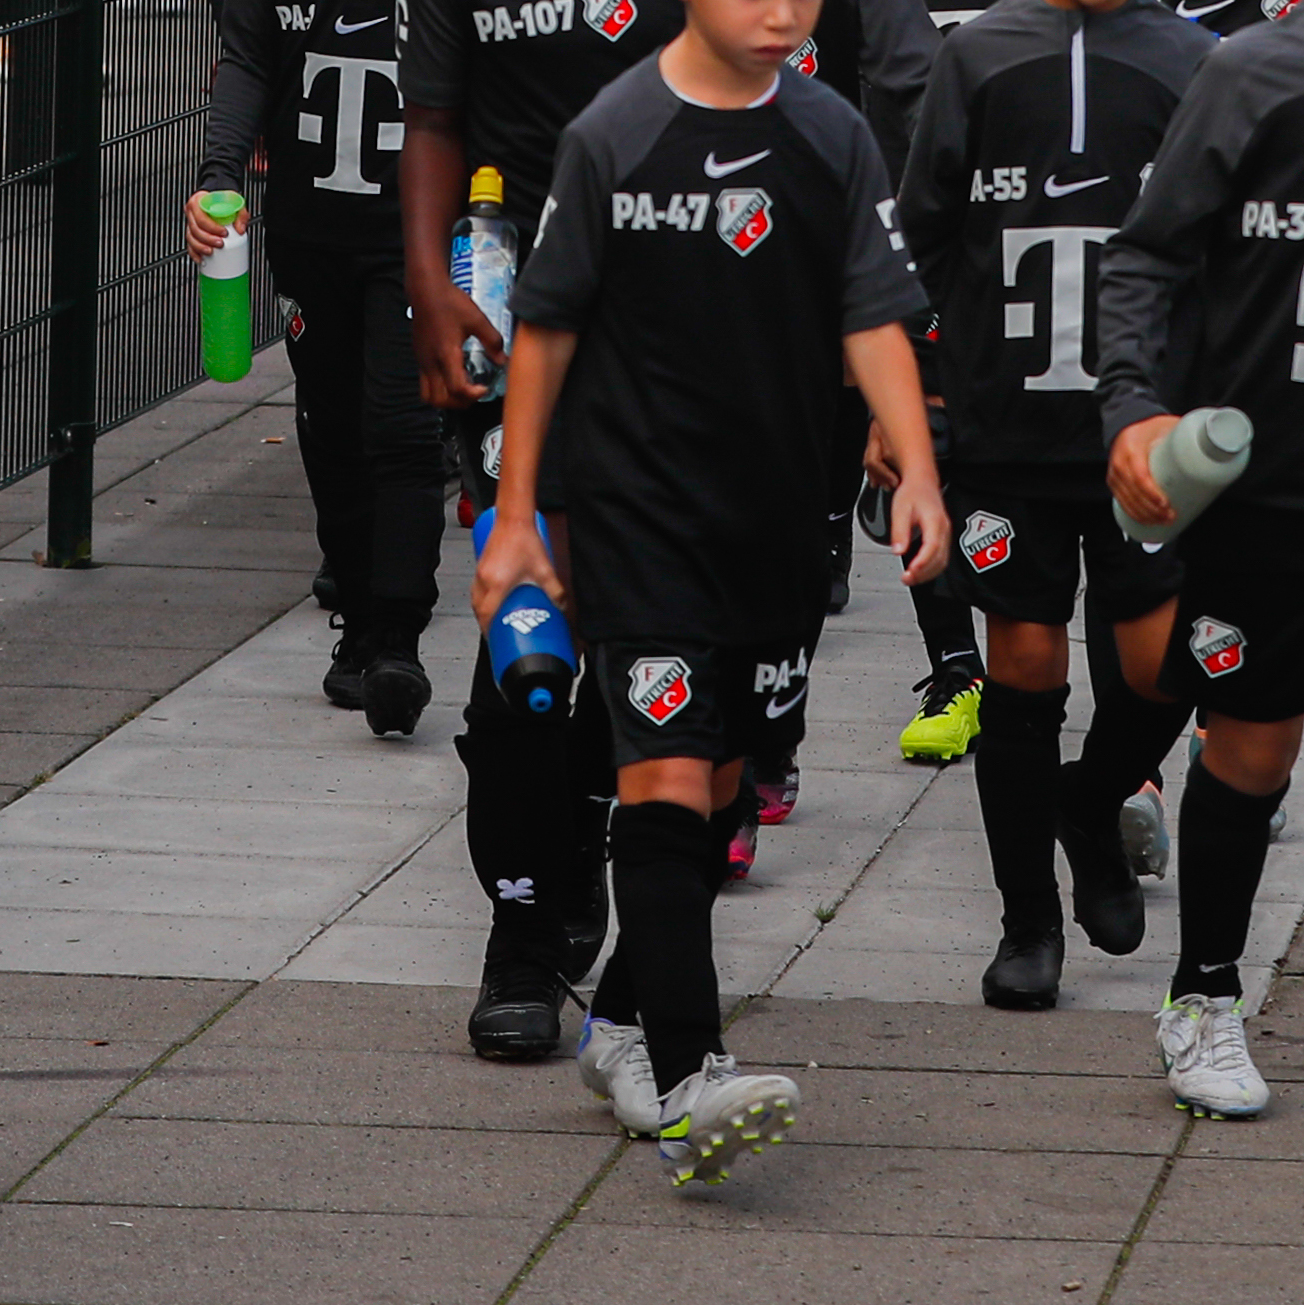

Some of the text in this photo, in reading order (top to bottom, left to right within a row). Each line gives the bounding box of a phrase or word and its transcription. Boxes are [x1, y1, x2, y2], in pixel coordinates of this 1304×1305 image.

[298, 51, 405, 195] T
[612, 192, 711, 232] PA-47
[966, 526, 1009, 556] UTRECHT
